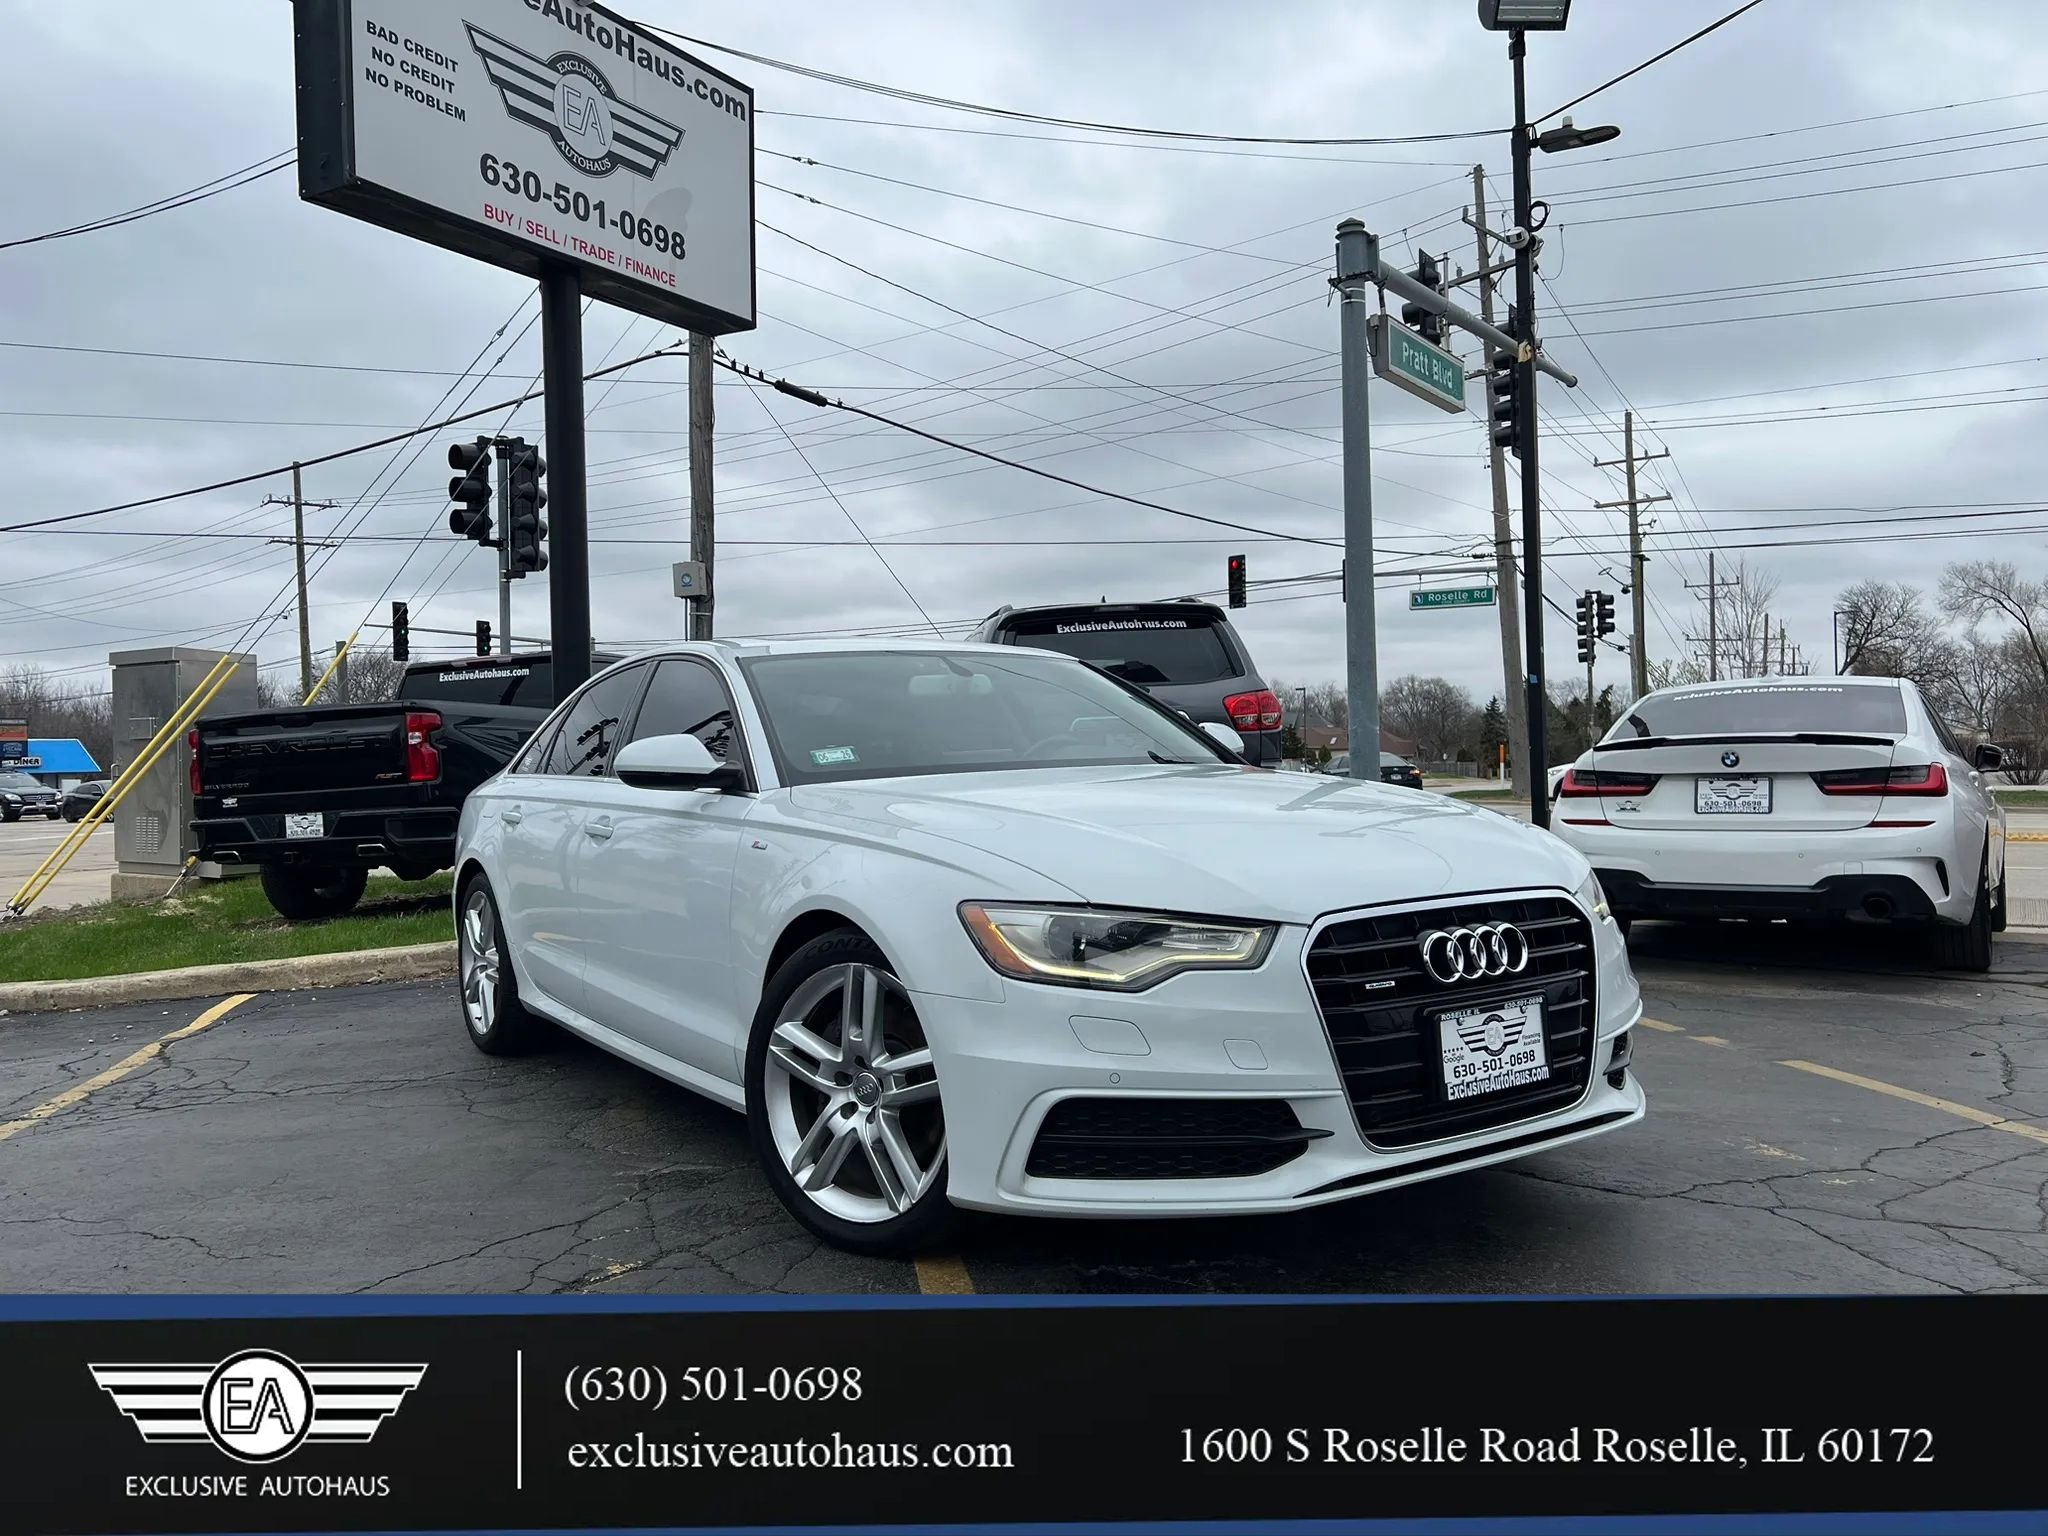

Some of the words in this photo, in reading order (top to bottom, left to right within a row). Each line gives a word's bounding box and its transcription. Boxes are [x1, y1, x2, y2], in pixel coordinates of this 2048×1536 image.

[366, 20, 399, 45] BAD
[403, 38, 459, 73] CREDIT
[371, 46, 395, 67] NO
[400, 60, 455, 94] CREDIT
[556, 60, 608, 94] EXCLUSIVE
[365, 67, 389, 88] NO
[394, 80, 466, 122] PROBLEM
[563, 84, 606, 146] EA
[556, 140, 612, 171] AUTOHAUS
[480, 153, 686, 260] 630-501-0698
[484, 203, 514, 227] BUY
[526, 220, 561, 245] SELL
[571, 237, 615, 265] TRADE
[625, 257, 676, 287] FINANCE
[1402, 341, 1429, 376] Pratt
[1432, 359, 1453, 389] Blvd
[1428, 591, 1468, 602] Roselle
[1473, 589, 1487, 599] Rd
[440, 668, 530, 682] ExclusiveAutohaus.com
[1441, 1009, 1472, 1021] ROSELLE
[1444, 1053, 1465, 1064] Google
[1453, 1049, 1536, 1079] 630-501-0698
[1448, 1065, 1550, 1101] ExclusiveAutoHaus.com
